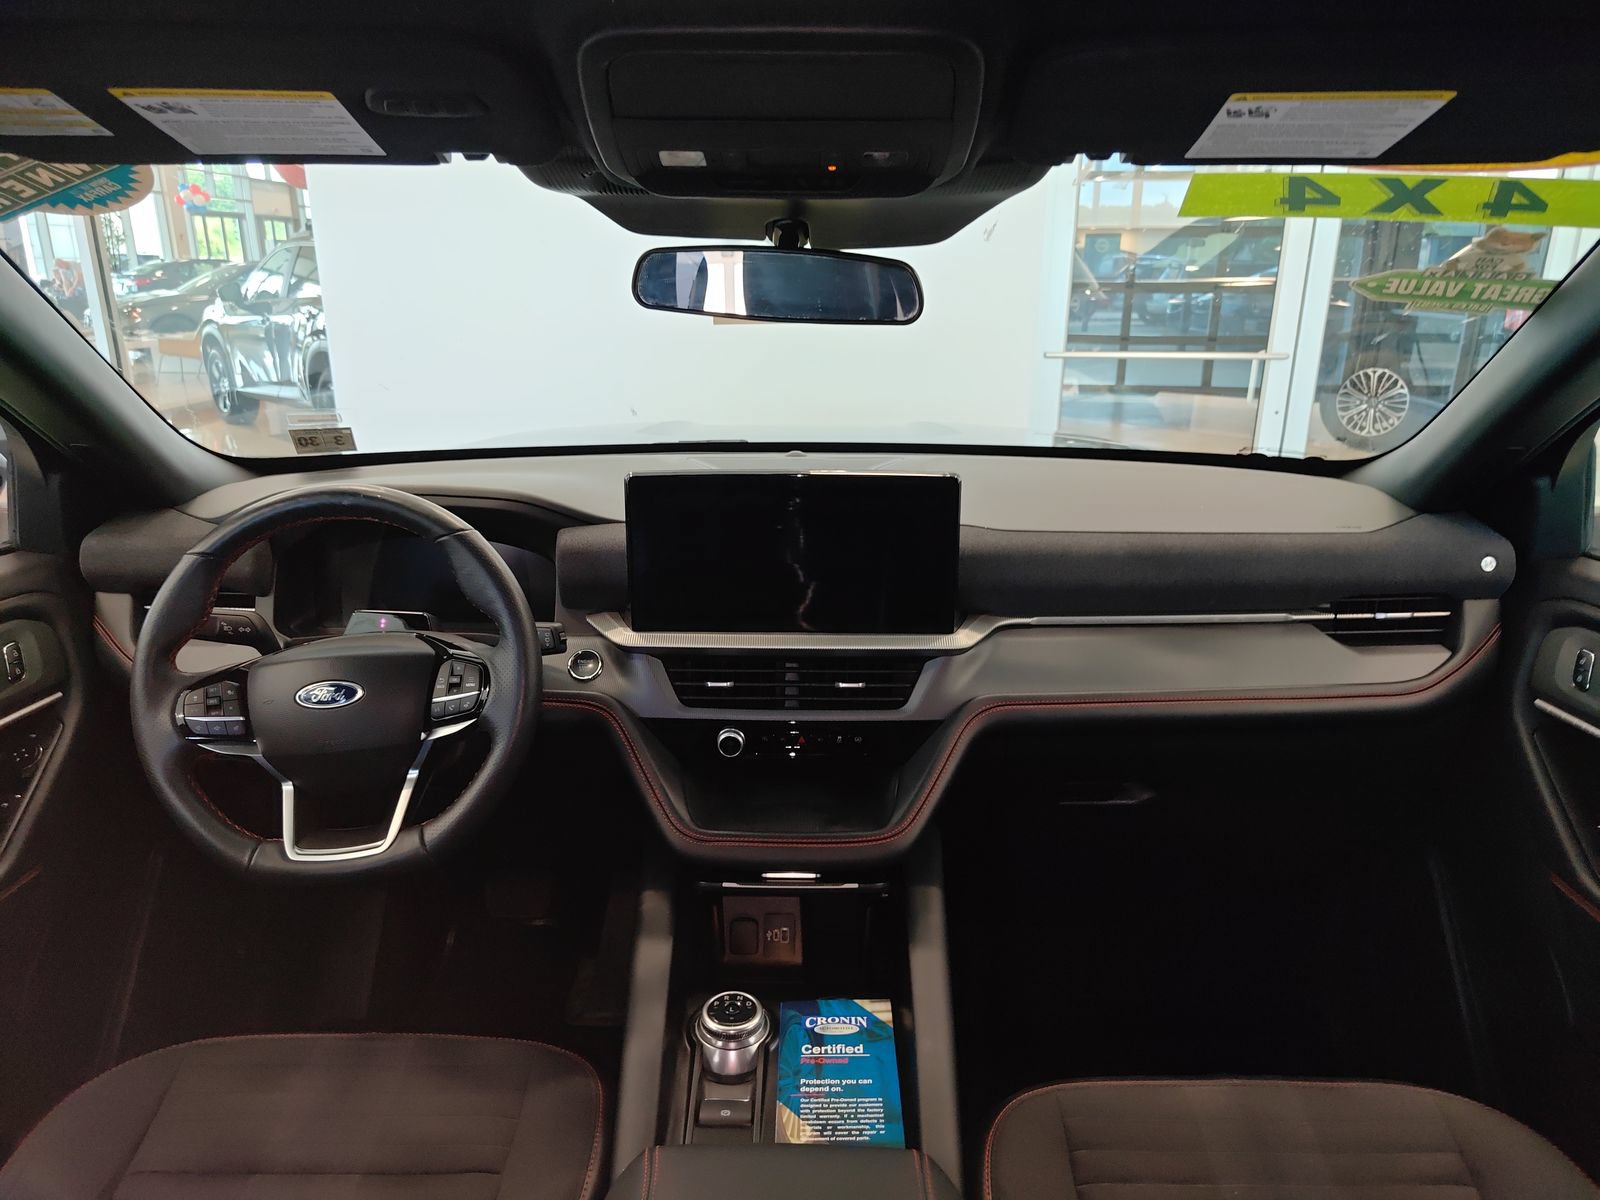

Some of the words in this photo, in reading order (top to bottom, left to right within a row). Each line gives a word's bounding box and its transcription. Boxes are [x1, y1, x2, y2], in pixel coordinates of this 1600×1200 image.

[309, 686, 347, 704] Ford
[805, 1016, 868, 1028] CRONIN
[801, 1044, 864, 1055] Certified
[800, 1057, 849, 1065] Pre-Owned
